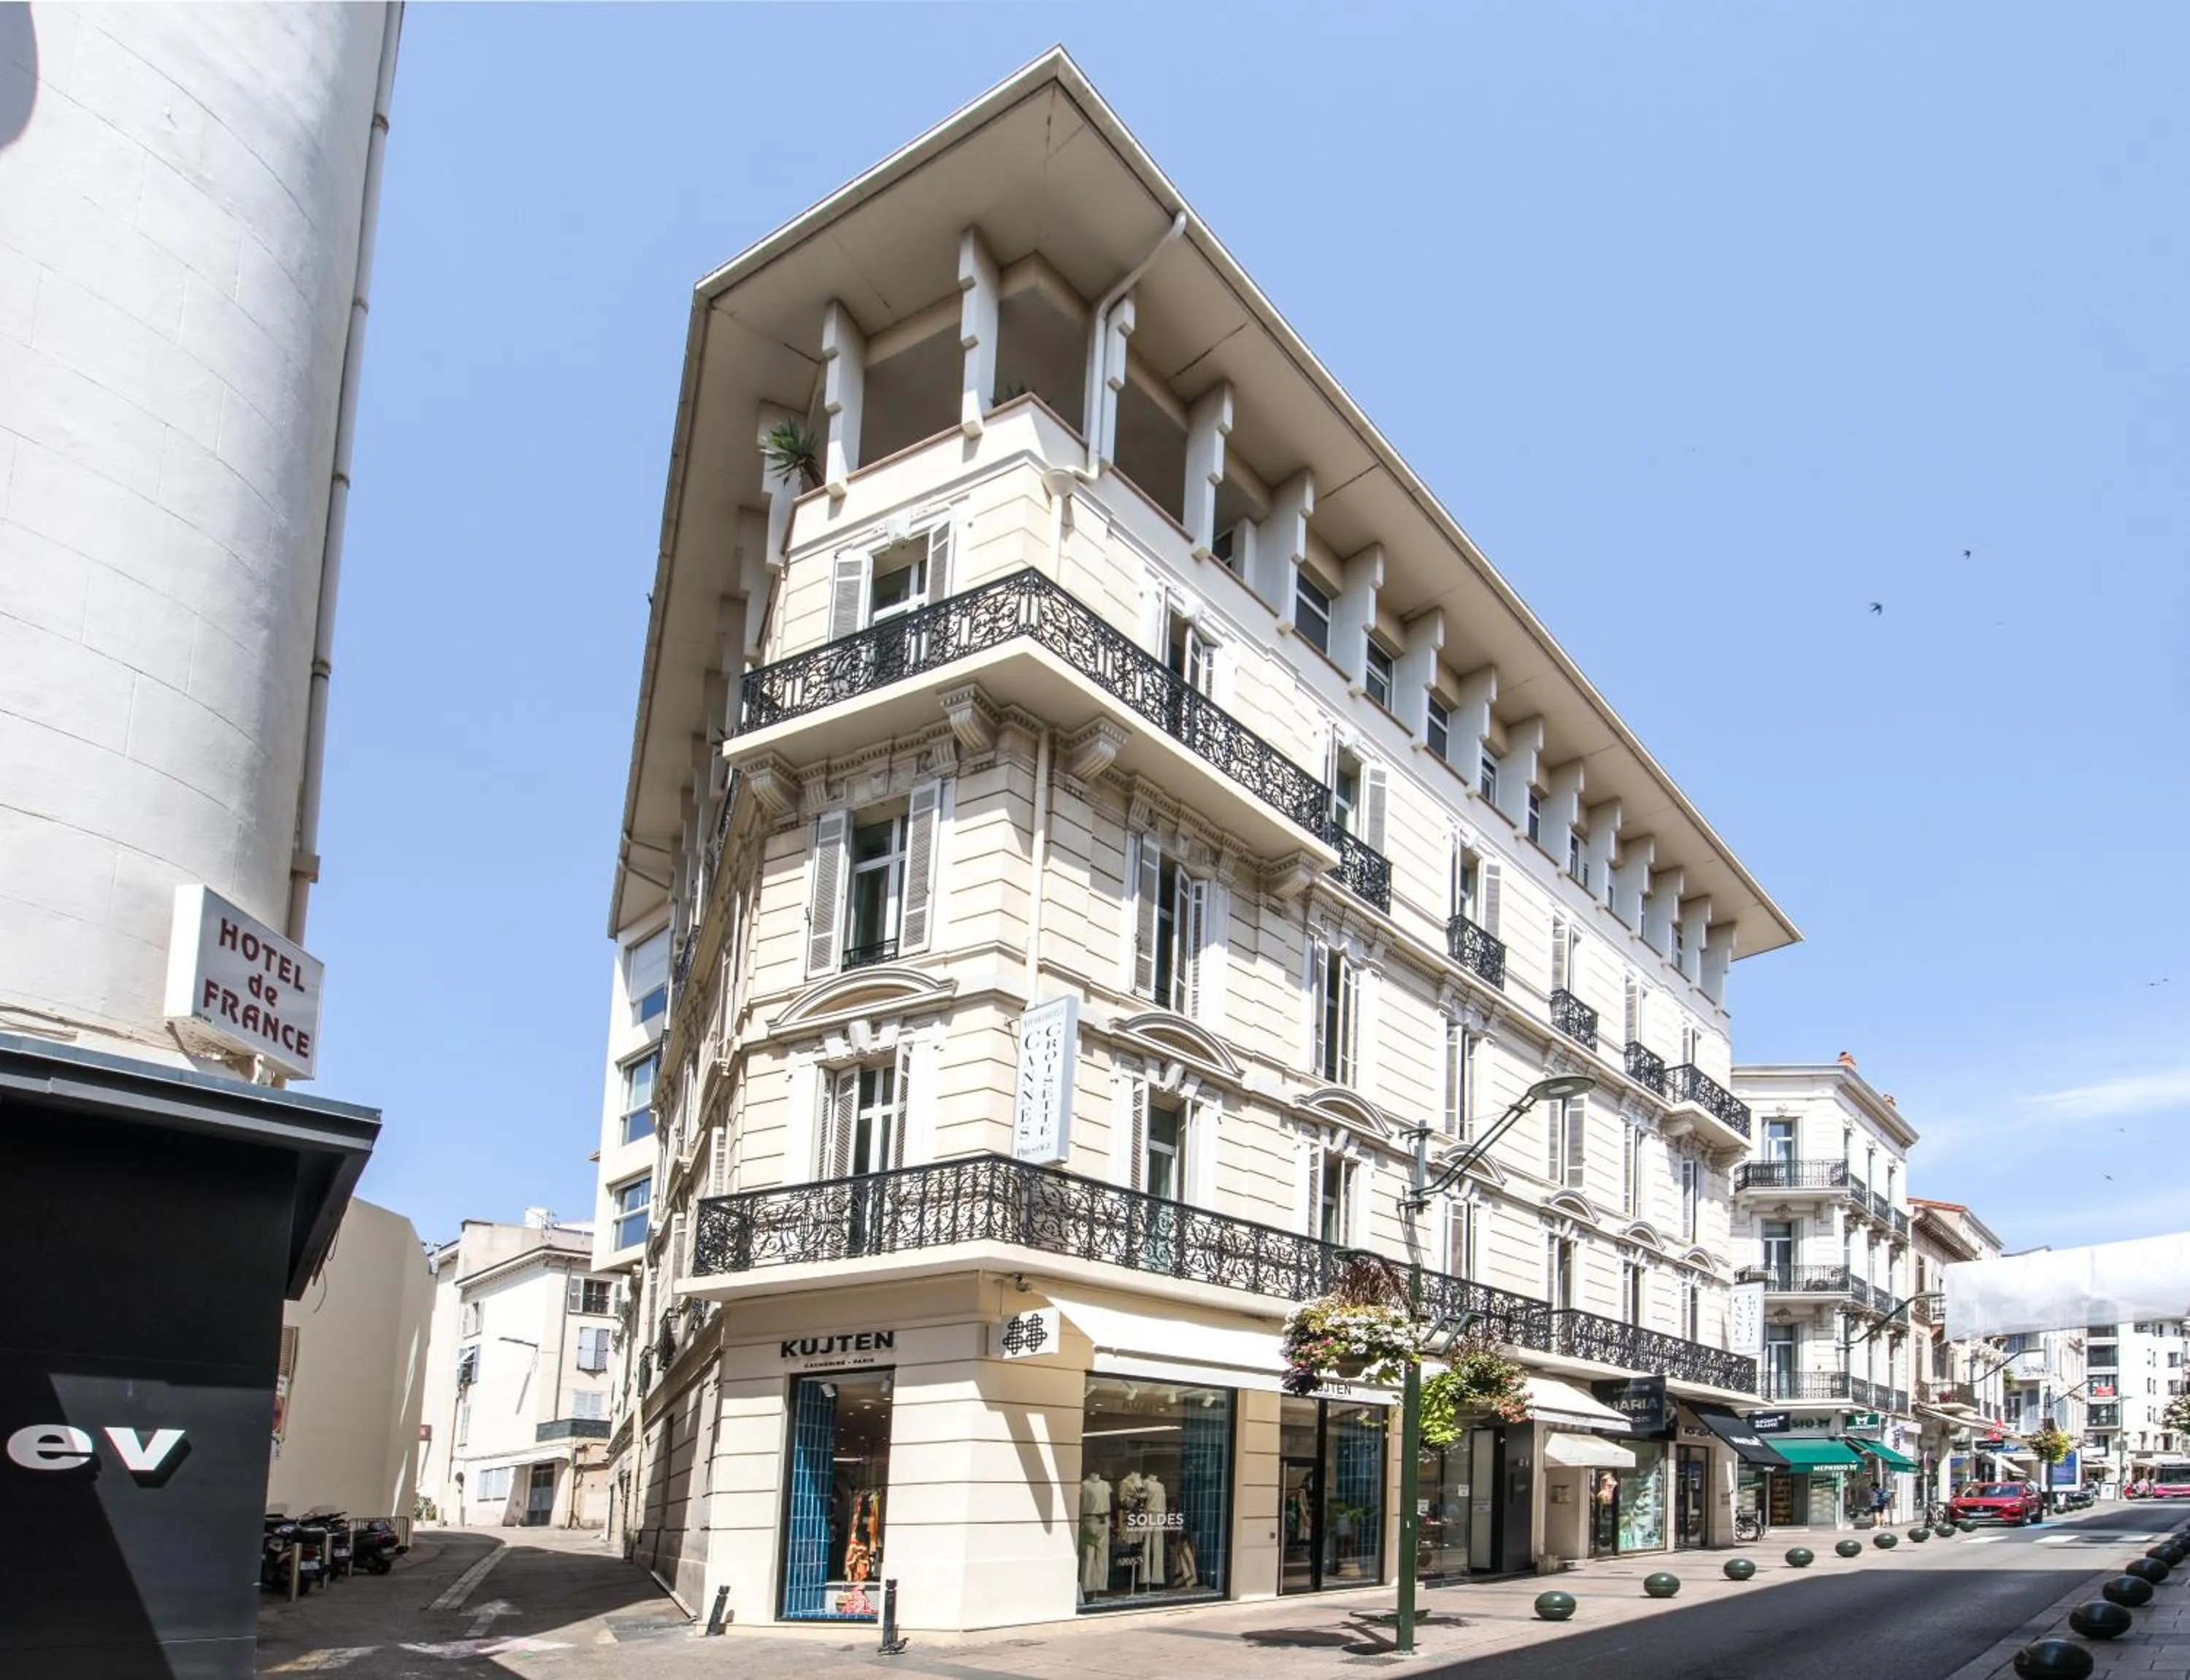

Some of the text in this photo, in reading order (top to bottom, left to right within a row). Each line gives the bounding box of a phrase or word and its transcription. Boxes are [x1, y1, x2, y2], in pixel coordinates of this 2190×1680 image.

[219, 917, 305, 993] HOTEL
[247, 973, 278, 1008] de
[202, 978, 310, 1059] FRANCE
[780, 1330, 894, 1358] KUJTEN
[853, 1357, 875, 1365] PARIS
[7, 1424, 186, 1471] ev
[1127, 1513, 1184, 1526] SOLDES
